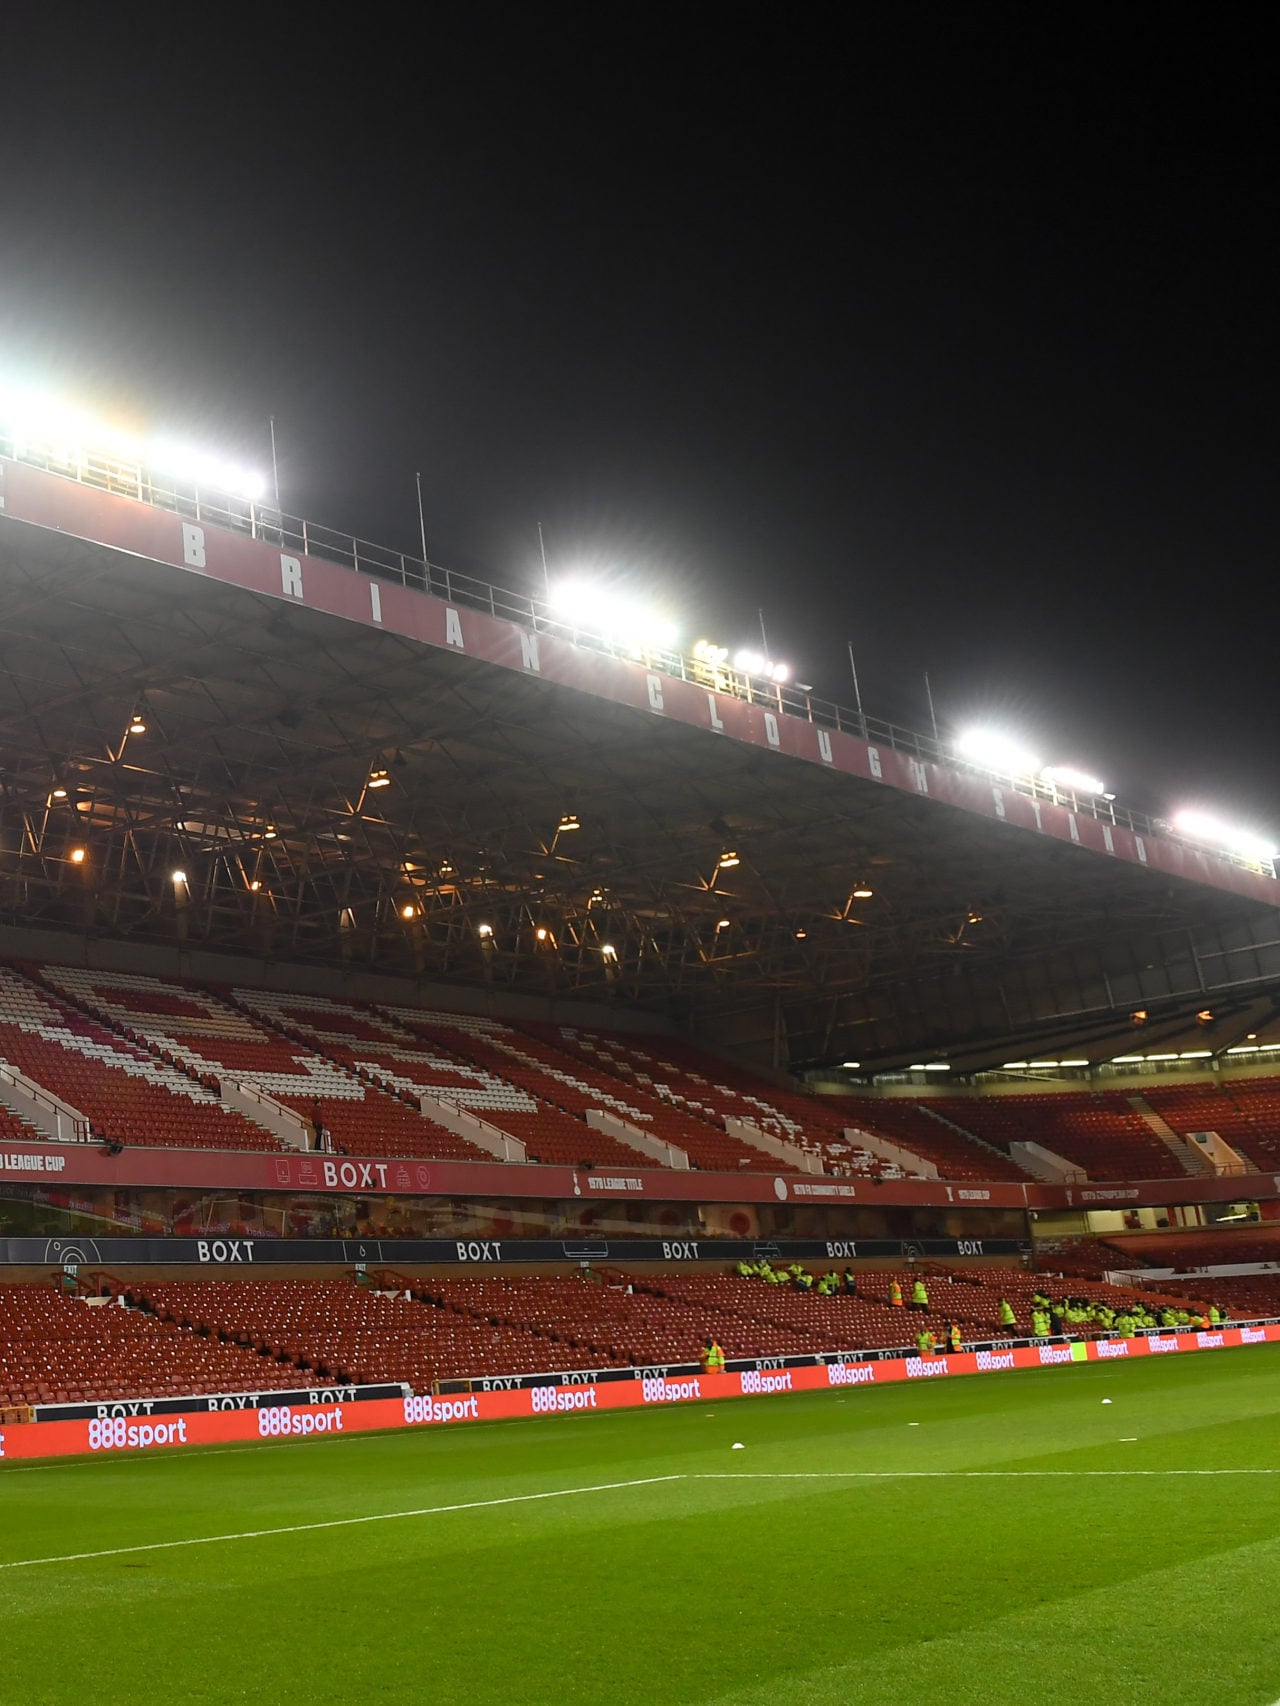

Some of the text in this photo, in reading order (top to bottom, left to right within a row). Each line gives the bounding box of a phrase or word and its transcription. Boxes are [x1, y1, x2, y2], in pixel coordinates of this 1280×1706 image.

[180, 521, 541, 672] BRIAN
[646, 674, 928, 793] CLOUGH
[992, 788, 1147, 862] STAND
[4, 1154, 45, 1171] LEAGUE
[45, 1156, 65, 1172] CUP
[323, 1161, 388, 1188] BOXT
[197, 1241, 255, 1262] BOXT
[457, 1242, 502, 1261] BOXT
[663, 1242, 699, 1260] BOXT
[826, 1241, 857, 1258] BOXT
[957, 1241, 984, 1255] BOXT
[905, 1356, 949, 1377] 888sport
[976, 1351, 1015, 1370] 888sport
[740, 1371, 793, 1393] 888sport
[827, 1363, 875, 1385] 888sport
[531, 1386, 597, 1412] 888sport
[642, 1377, 701, 1402] 888sport
[404, 1395, 478, 1422] 888sport
[88, 1416, 187, 1449] 888sport
[258, 1406, 343, 1437] 888sport
